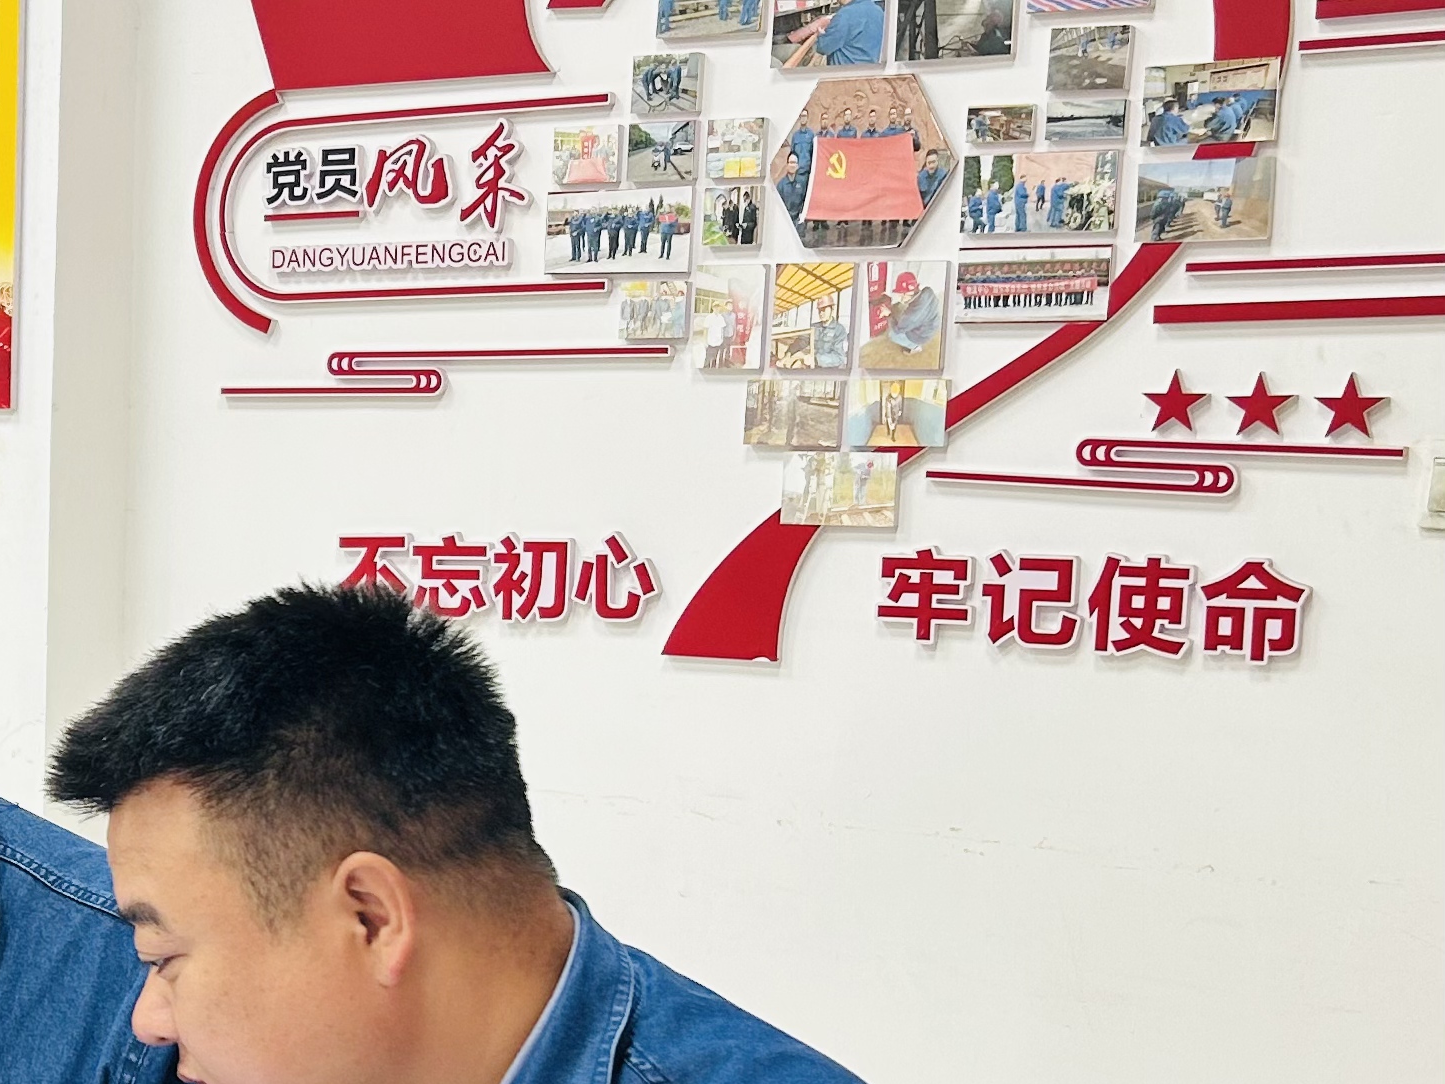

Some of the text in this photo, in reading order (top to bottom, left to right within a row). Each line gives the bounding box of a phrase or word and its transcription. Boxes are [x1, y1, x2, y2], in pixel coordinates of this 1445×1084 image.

[266, 122, 526, 229] 党员风采
[271, 241, 507, 269] DANGYUANFENGCAI
[338, 534, 656, 621] 不忘初心
[877, 547, 1307, 662] 牢记使命
